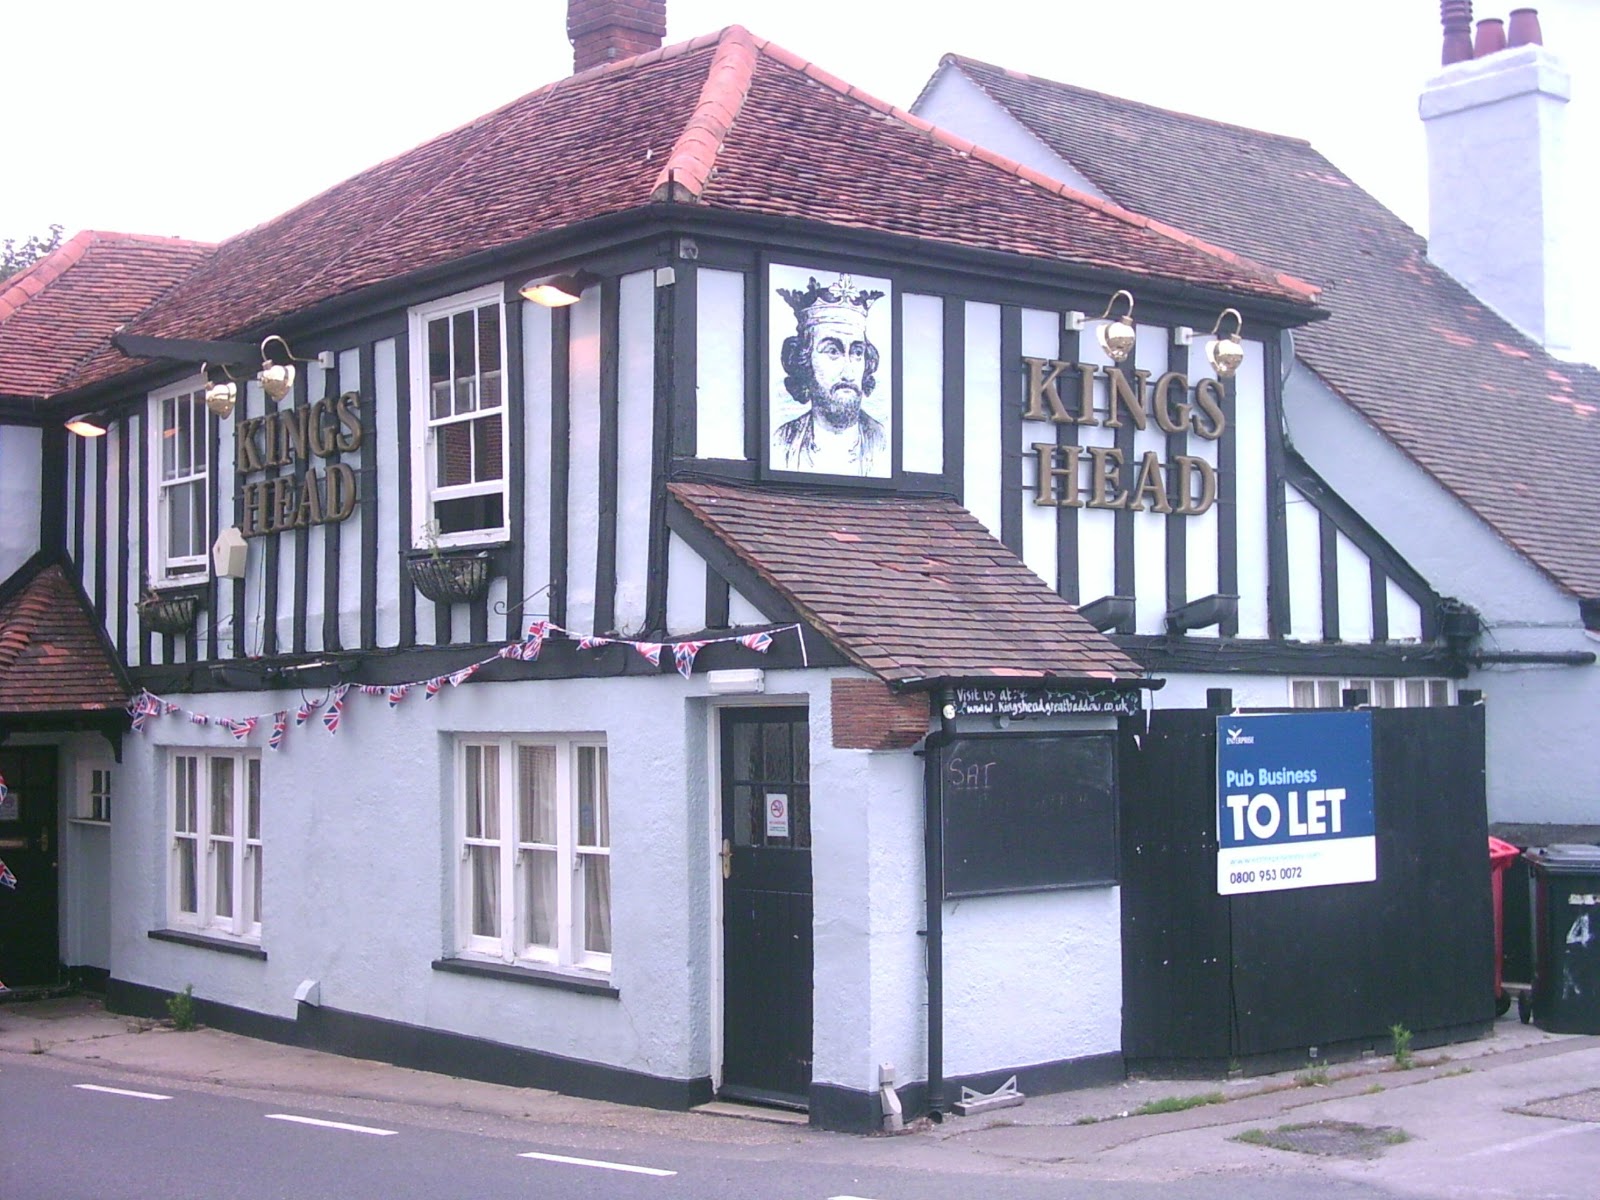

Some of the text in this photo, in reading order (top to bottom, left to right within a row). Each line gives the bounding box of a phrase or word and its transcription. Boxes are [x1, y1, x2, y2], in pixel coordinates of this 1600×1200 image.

[1021, 356, 1226, 440] KINGS
[237, 390, 362, 474] KINGS
[1031, 442, 1217, 515] HEAD
[241, 463, 357, 539] HEAD
[956, 688, 981, 702] Visit
[983, 690, 996, 701] us
[949, 757, 997, 787] SAT
[1226, 767, 1318, 787] Pub Business
[1226, 788, 1347, 841] TO LET
[1230, 867, 1303, 884] 0800 953 0072
[1566, 913, 1592, 946] 4
